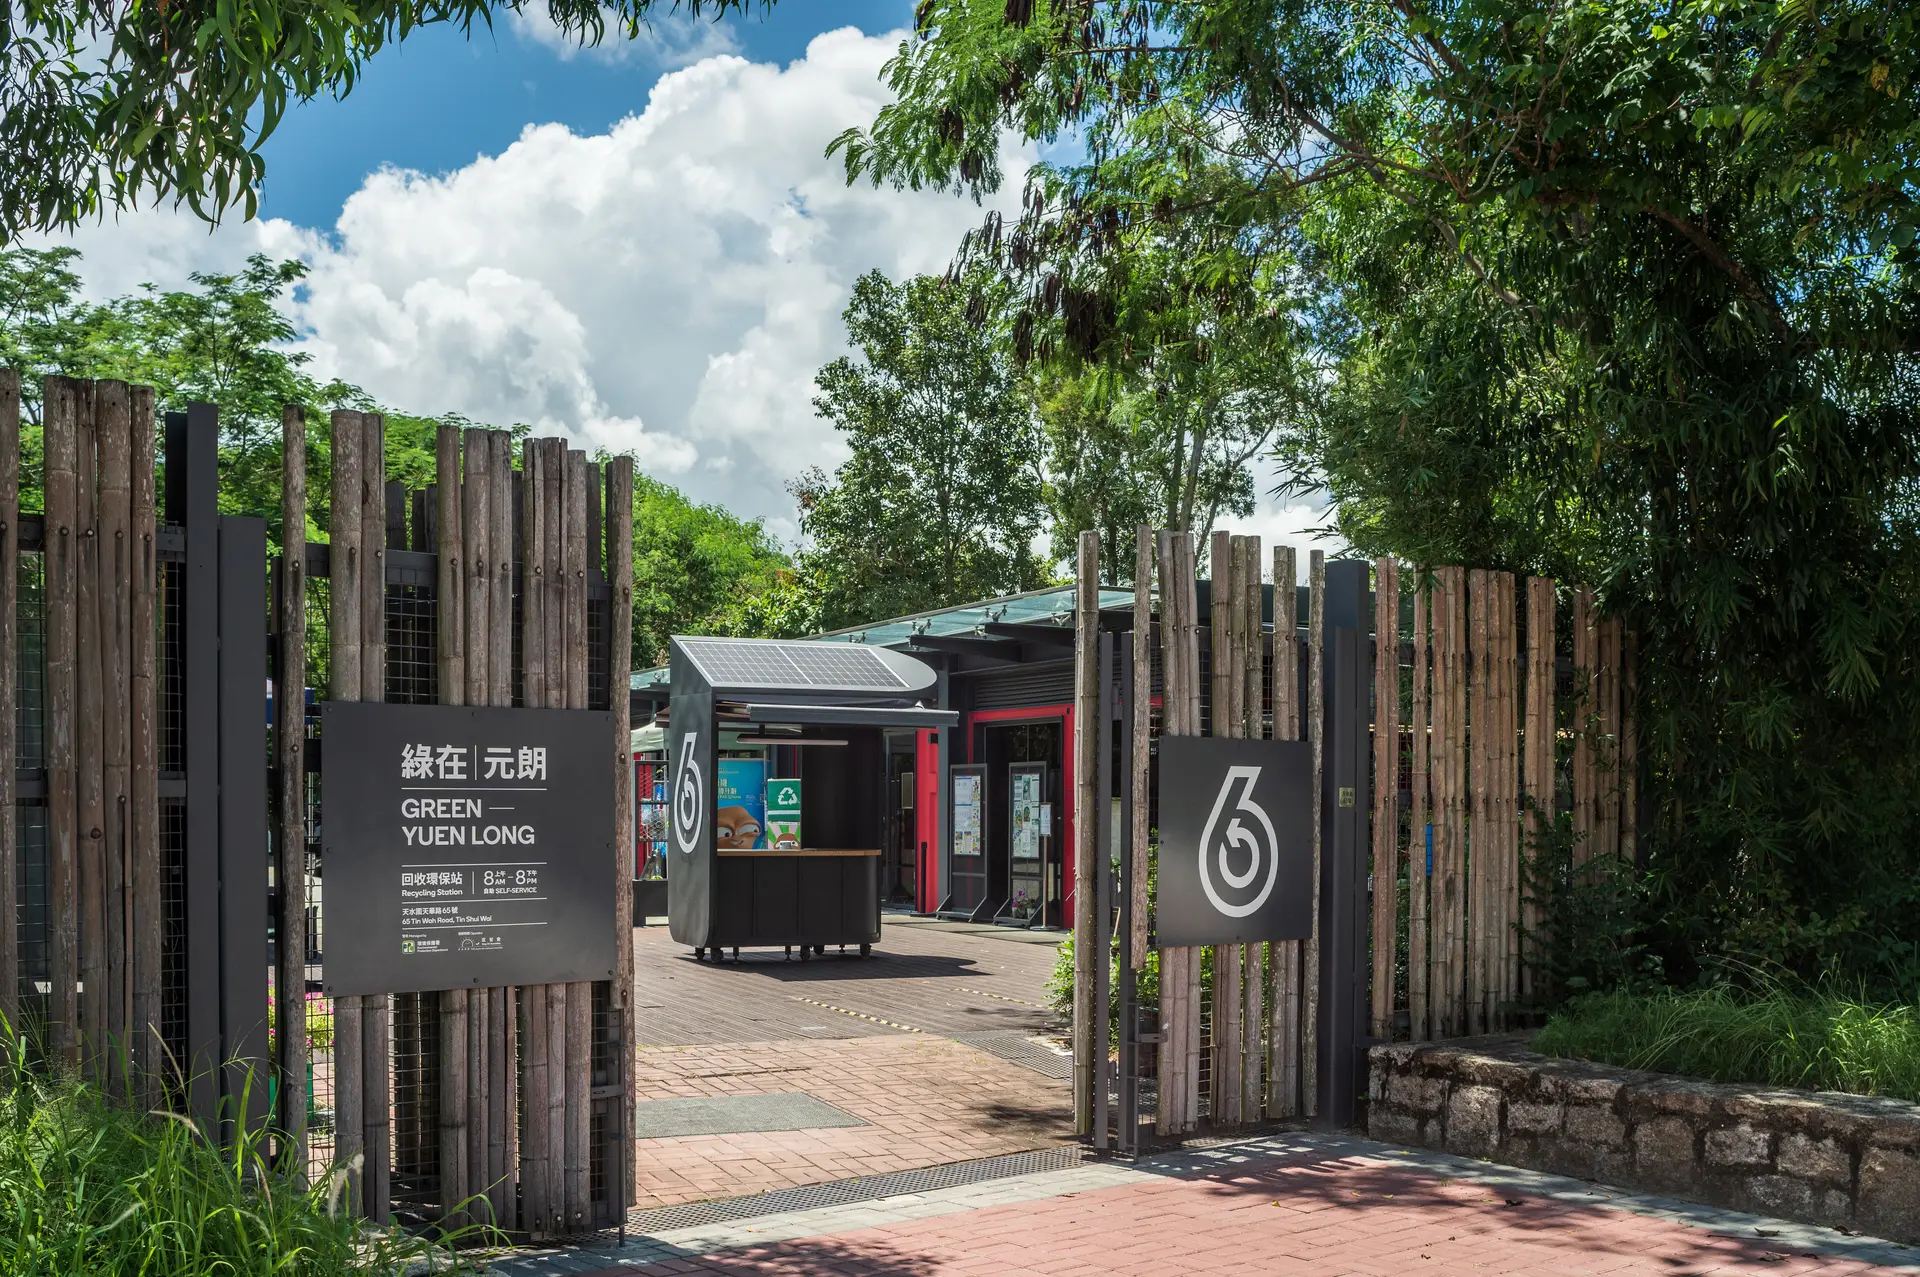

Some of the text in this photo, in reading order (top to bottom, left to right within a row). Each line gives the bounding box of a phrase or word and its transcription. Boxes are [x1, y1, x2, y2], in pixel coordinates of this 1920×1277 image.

[401, 743, 547, 781] 綠在 元朗
[401, 798, 482, 819] GREEN
[401, 825, 535, 846] YUEN LONG
[402, 872, 463, 886] 回收環保站
[483, 870, 494, 886] 8
[515, 869, 526, 885] 8
[402, 888, 463, 899] Recycling Station
[495, 887, 538, 895] SELF-SERVICE
[411, 917, 421, 925] Tin
